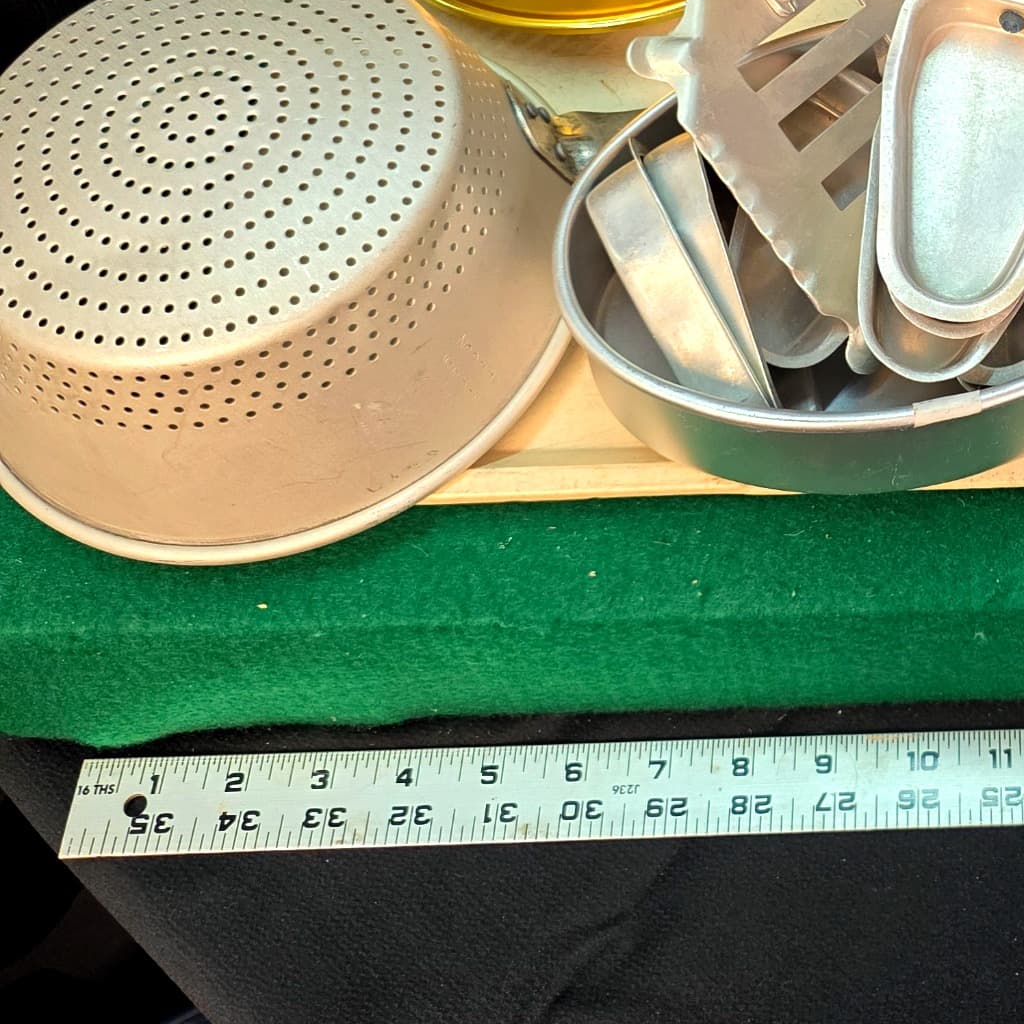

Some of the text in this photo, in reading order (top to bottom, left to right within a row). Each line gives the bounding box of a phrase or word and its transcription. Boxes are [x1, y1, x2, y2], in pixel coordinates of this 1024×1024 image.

[150, 774, 161, 795] 1
[224, 772, 245, 792] 2
[310, 769, 330, 790] 3
[395, 767, 414, 787] 4
[480, 765, 499, 785] 5
[565, 762, 583, 782] 6
[649, 760, 668, 779] 7
[732, 757, 750, 777] 8
[815, 754, 833, 774] 9
[907, 750, 939, 771] 10
[989, 748, 1012, 768] 11
[78, 784, 116, 795] 16 THS
[611, 784, 640, 795] J236
[898, 788, 940, 810] 26
[981, 786, 1022, 807] 25
[561, 799, 603, 820] 30
[646, 797, 688, 818] 29
[731, 794, 772, 815] 28
[815, 791, 856, 812] 27
[129, 812, 174, 834] 35
[218, 810, 261, 832] 34
[302, 807, 347, 828] 33
[389, 804, 433, 825] 32
[483, 802, 518, 823] 31
